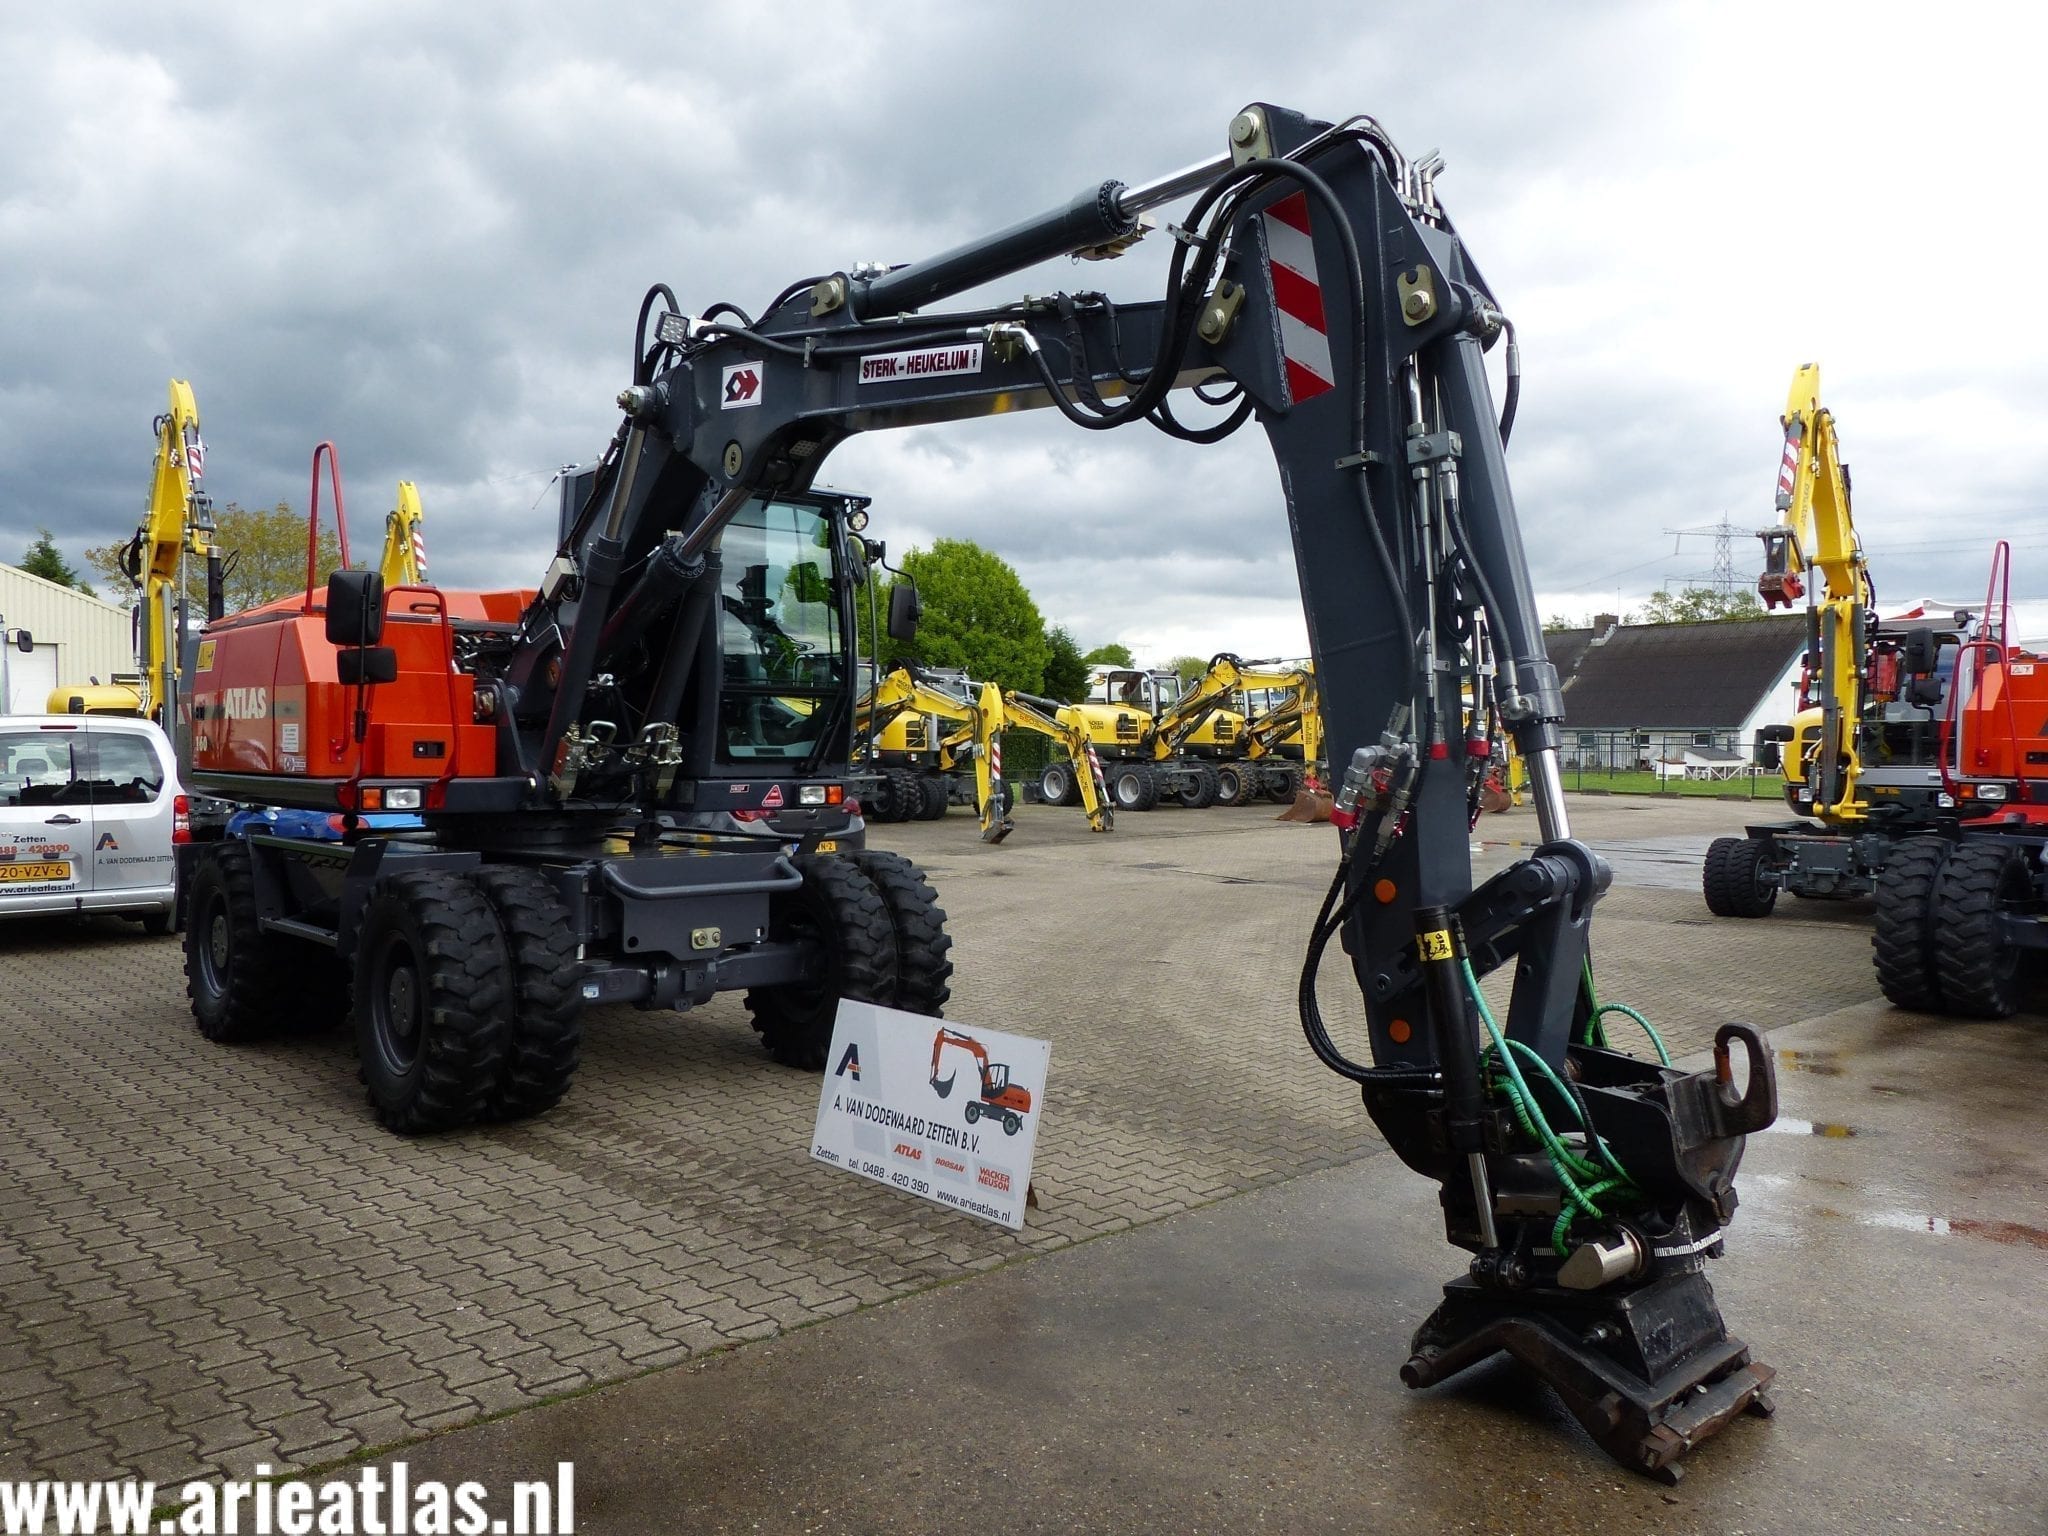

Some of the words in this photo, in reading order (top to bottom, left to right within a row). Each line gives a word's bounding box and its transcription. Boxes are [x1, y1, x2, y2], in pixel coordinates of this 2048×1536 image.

[863, 357, 898, 379] STERK
[906, 349, 970, 375] HEUKELUM
[223, 687, 268, 720] ATLAS
[13, 833, 46, 843] Zetten
[28, 844, 70, 854] 420390
[106, 857, 118, 865] VAN
[0, 864, 64, 879] 20-VZV-6
[833, 1094, 842, 1111] A.
[846, 1097, 865, 1118] VAN
[865, 1103, 925, 1136] DODEWAARD
[926, 1121, 960, 1147] ZETTEN
[961, 1131, 981, 1154] B.V.
[894, 1143, 922, 1161] ATLAS
[935, 1157, 965, 1173] DOOSAN
[977, 1175, 1010, 1192] NEUSON
[979, 1166, 1010, 1184] WACKER
[816, 1145, 840, 1163] Zetten
[862, 1161, 885, 1179] 0488
[891, 1172, 909, 1187] 420
[910, 1178, 929, 1194] 390
[936, 1189, 1011, 1223] www.arieatlas.nl
